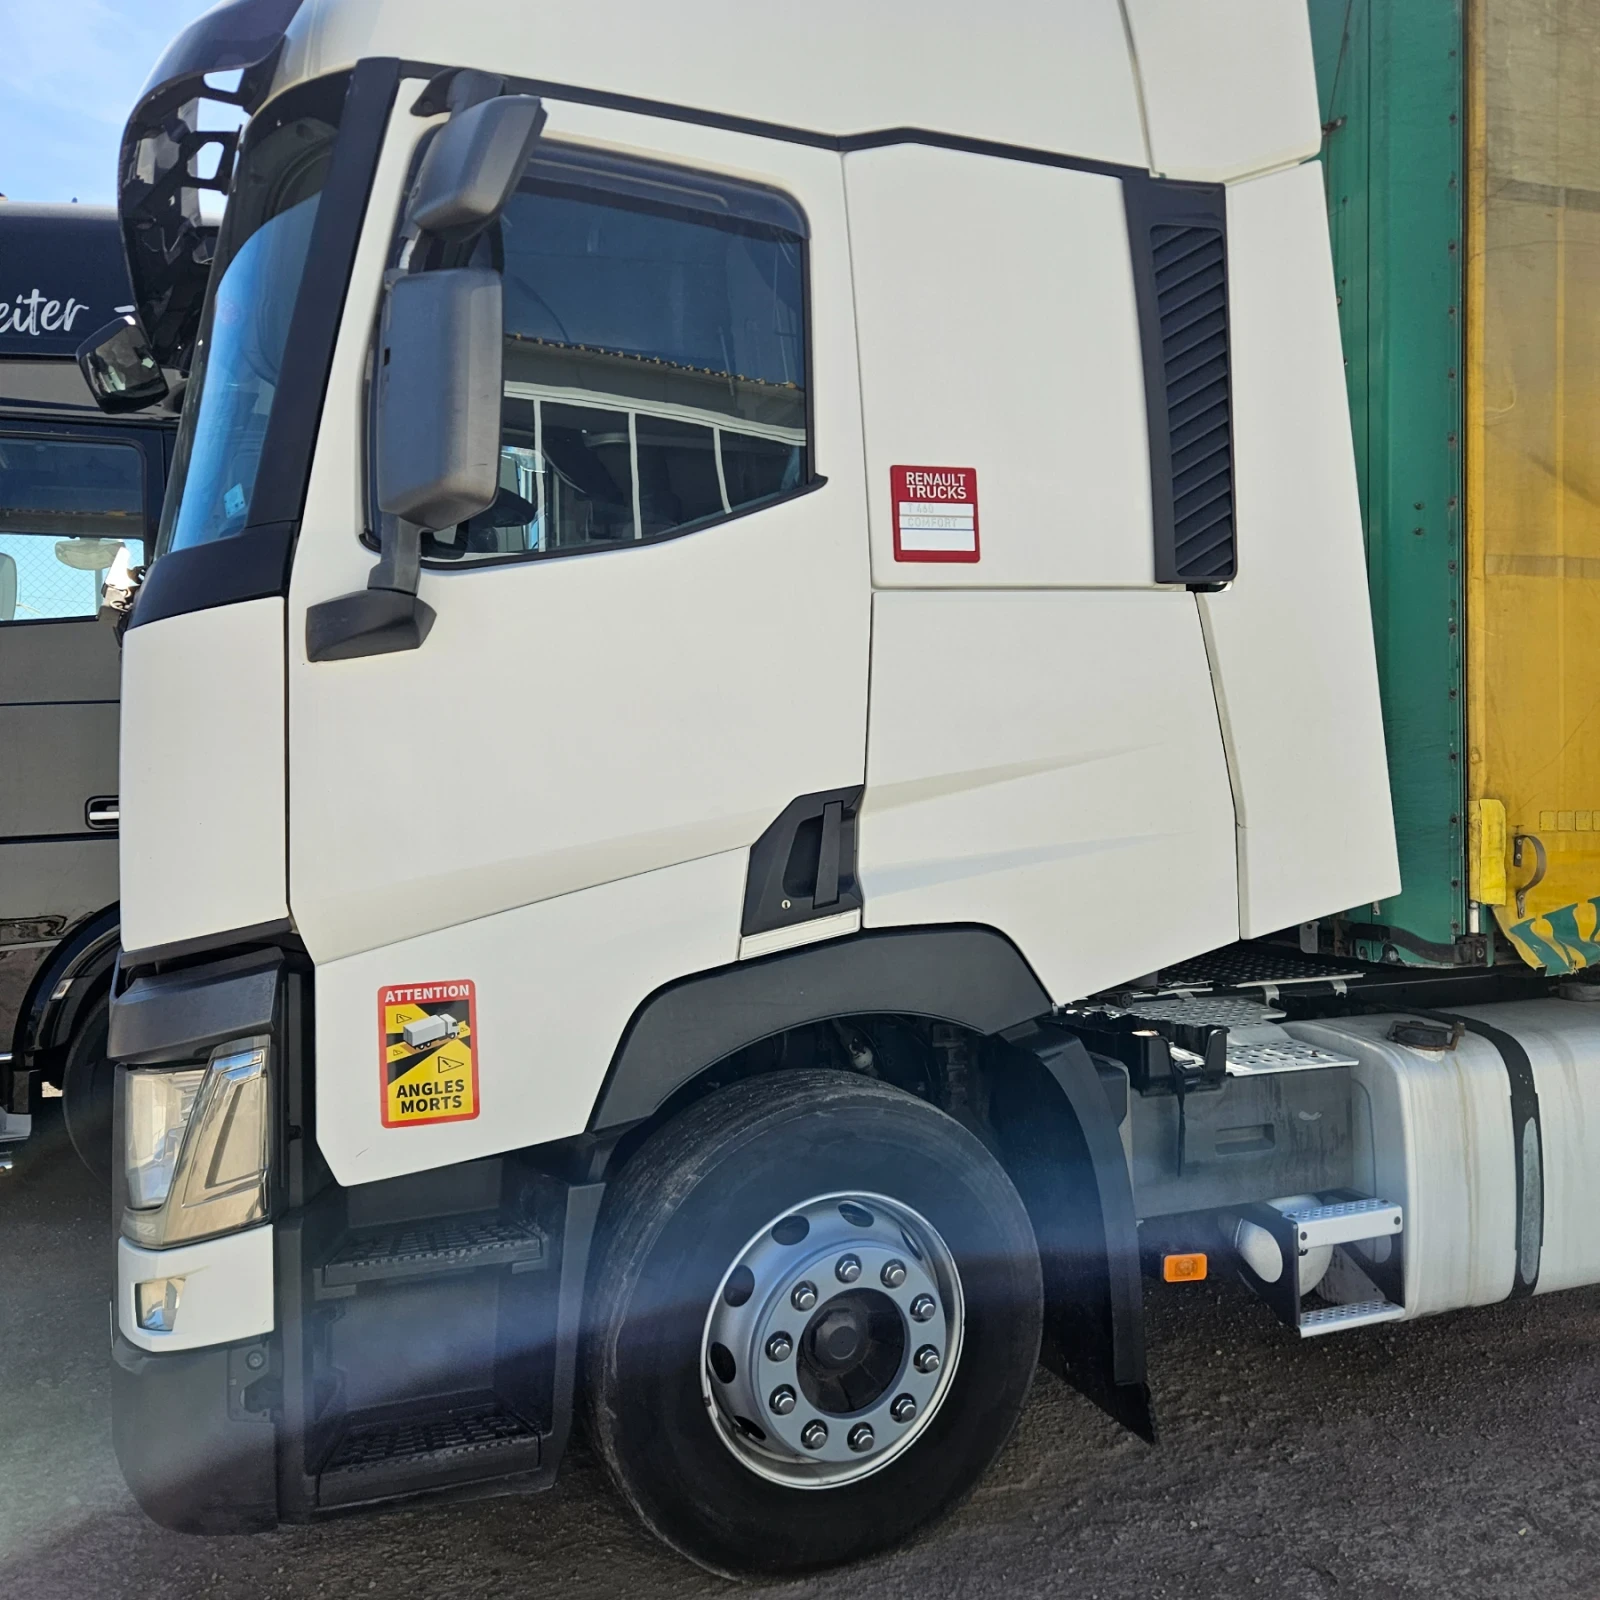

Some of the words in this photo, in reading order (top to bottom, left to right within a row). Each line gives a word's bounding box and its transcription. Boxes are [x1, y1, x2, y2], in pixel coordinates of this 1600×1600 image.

[906, 472, 966, 486] RENAULT
[907, 485, 967, 499] TRUCKS
[907, 517, 958, 528] COMFORT
[385, 984, 470, 1003] ATTENTION
[396, 1079, 465, 1099] ANGLES
[401, 1095, 463, 1114] MORTS
